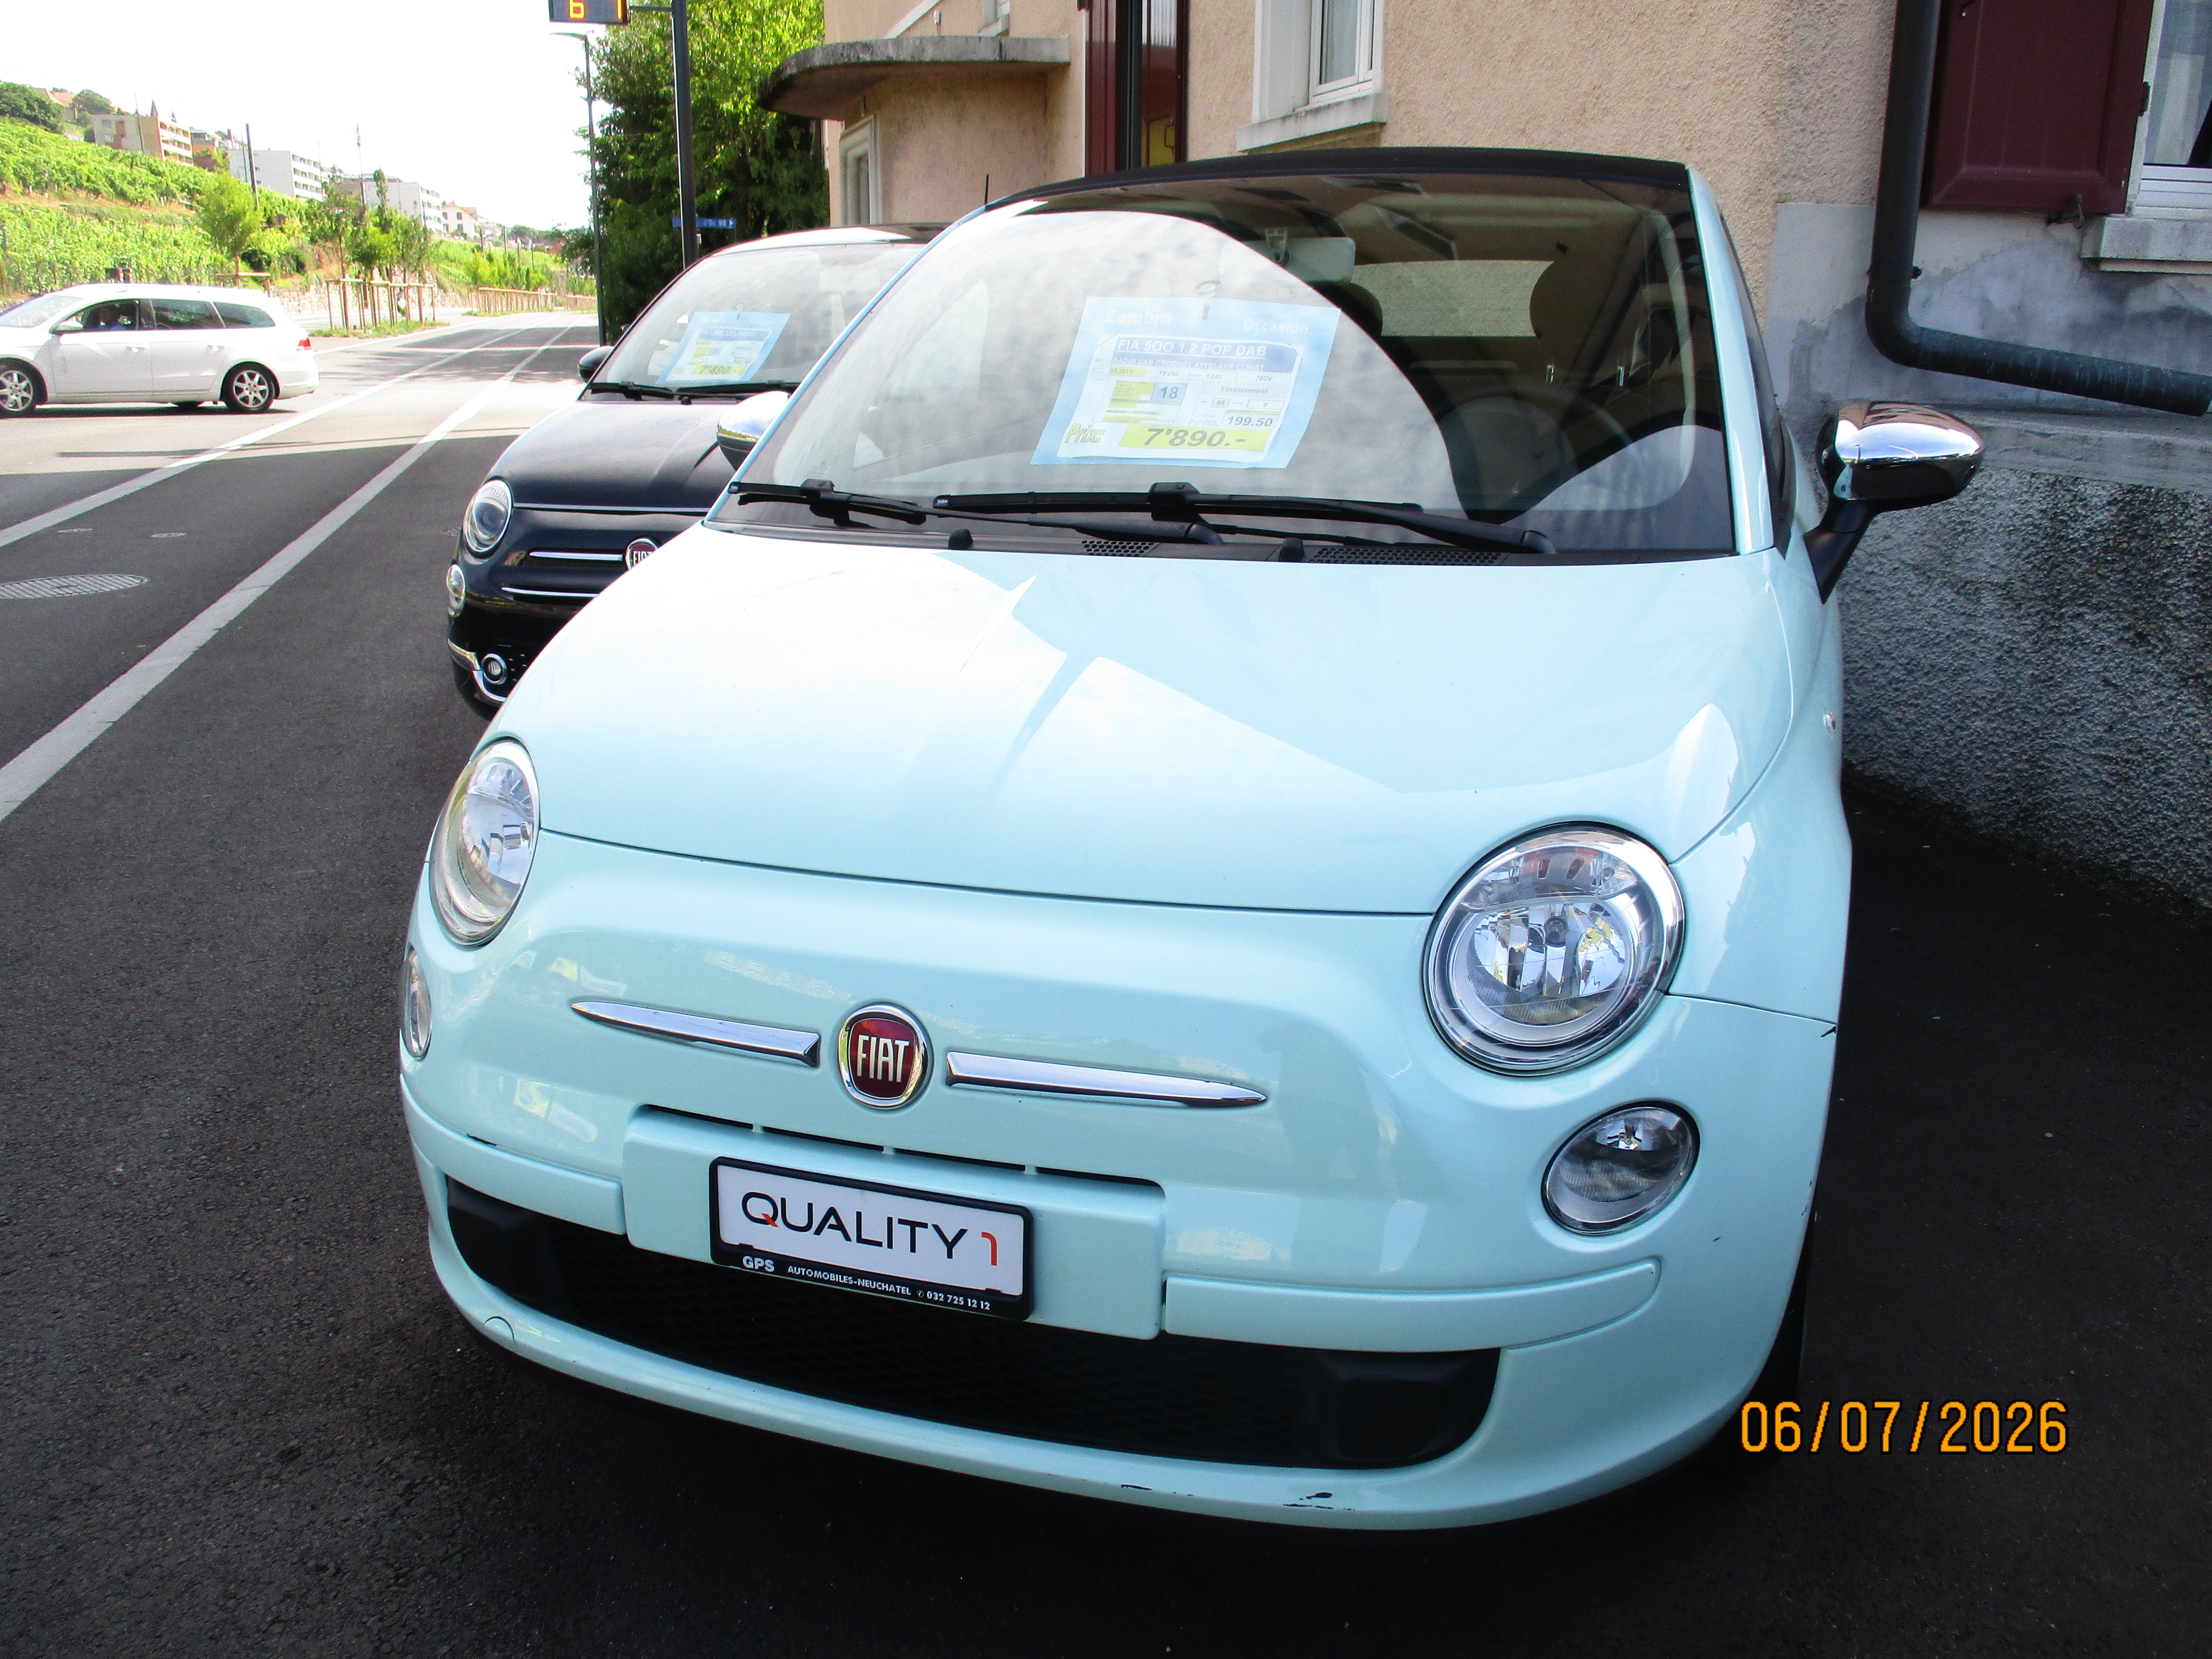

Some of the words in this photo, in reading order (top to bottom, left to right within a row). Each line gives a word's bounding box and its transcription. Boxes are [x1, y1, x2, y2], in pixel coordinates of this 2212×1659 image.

[1244, 318, 1309, 334] Occasion
[1117, 340, 1139, 351] FIA
[1144, 341, 1173, 352] 500
[1179, 343, 1196, 354] 1.2
[1201, 344, 1232, 356] POP
[1235, 345, 1266, 357] DAB
[1161, 386, 1179, 399] 18
[1228, 416, 1273, 427] 199.50
[1144, 428, 1246, 447] 7'890.-
[633, 551, 653, 565] FI
[857, 1035, 911, 1083] FIAT
[741, 1191, 968, 1259] QUALITY
[981, 1232, 997, 1266] 1
[742, 1255, 775, 1272] GPS
[787, 1266, 911, 1296] AUTOMOBILES-NEUCHATEL
[927, 1291, 944, 1302] 032
[947, 1294, 964, 1306] 725
[967, 1298, 978, 1308] 12
[979, 1300, 990, 1310] 12
